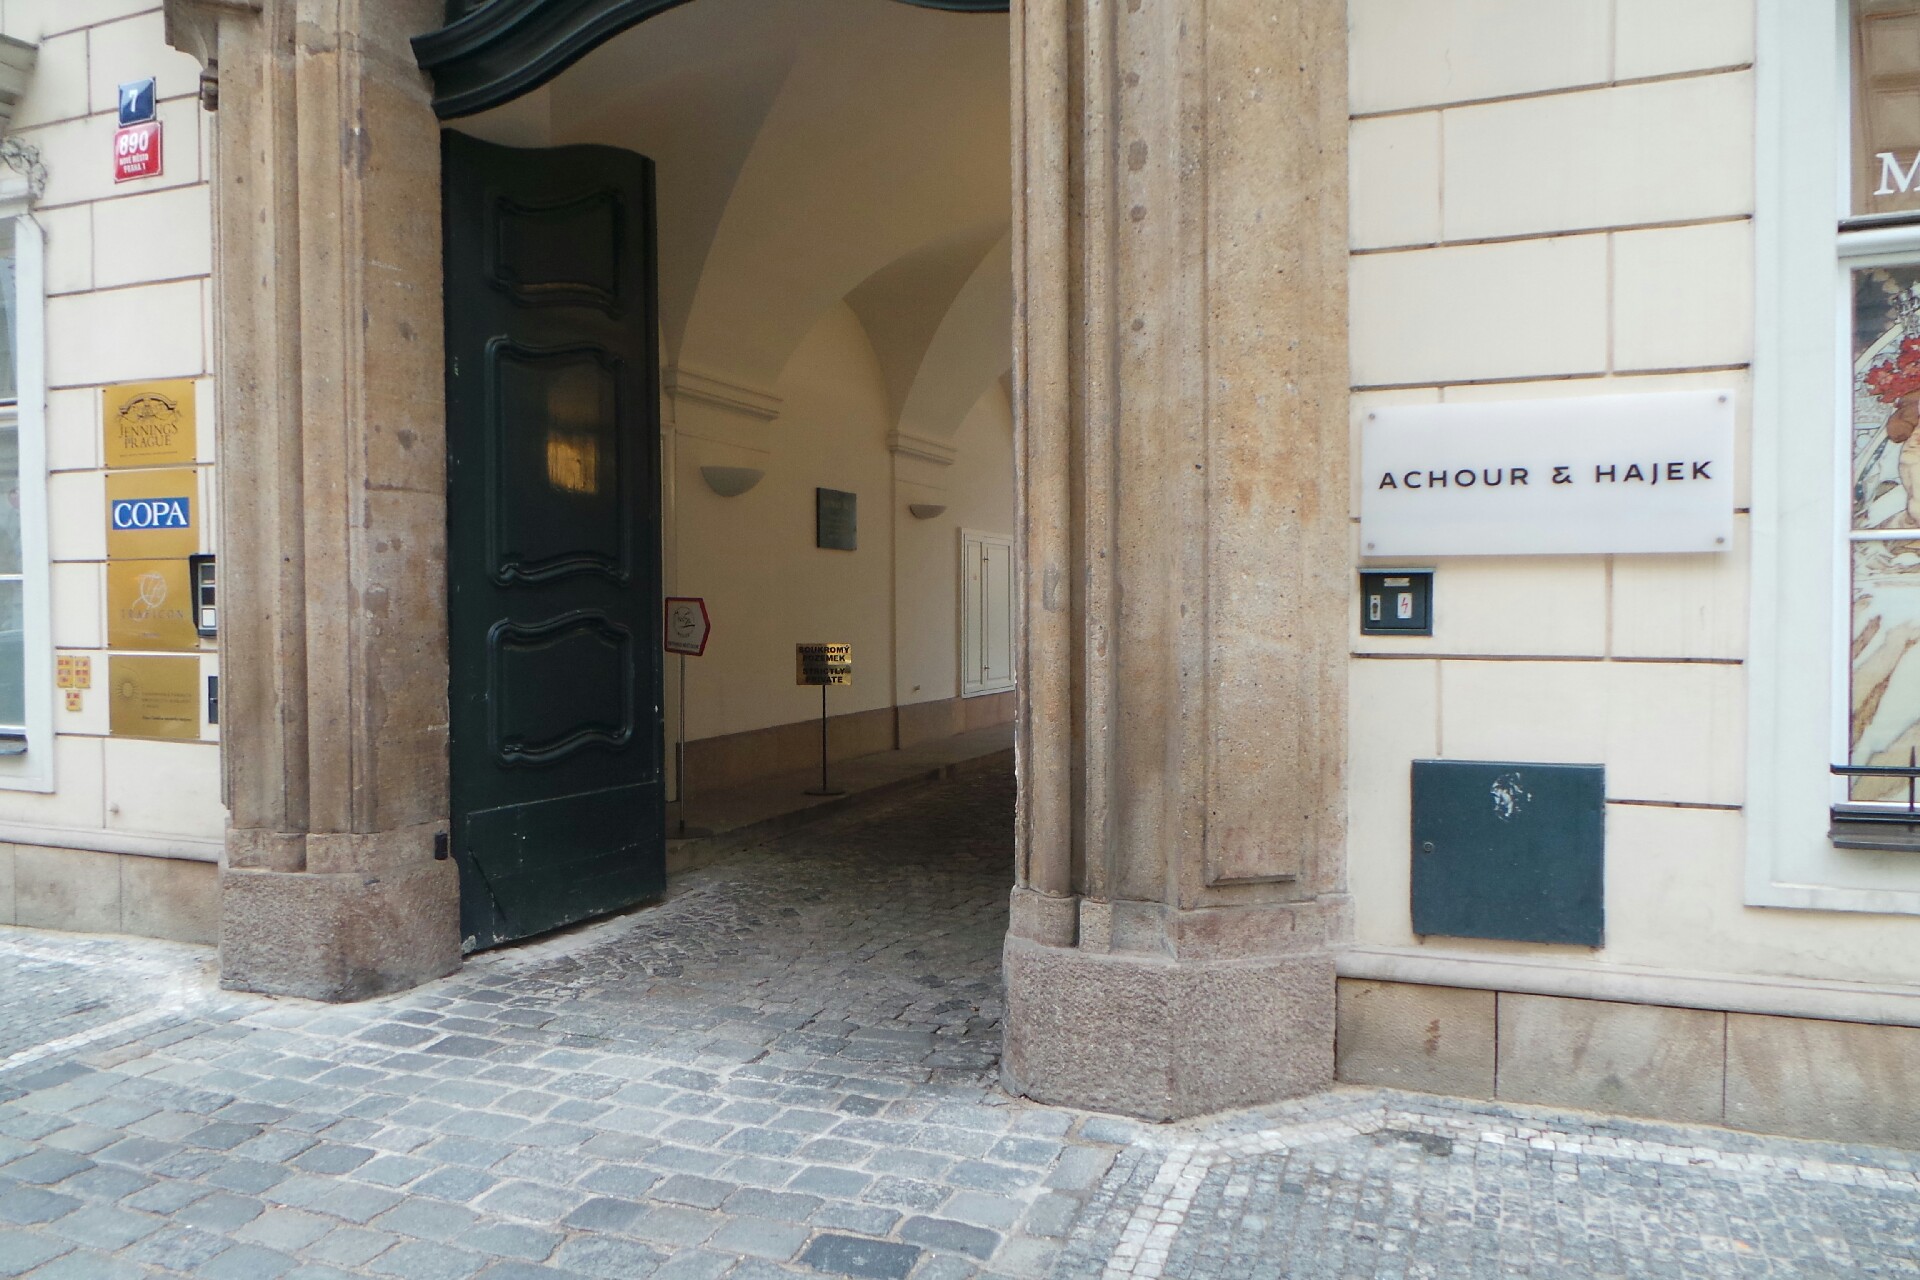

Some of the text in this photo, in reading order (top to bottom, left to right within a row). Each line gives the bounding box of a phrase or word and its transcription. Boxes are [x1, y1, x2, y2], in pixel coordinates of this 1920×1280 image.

[129, 89, 139, 113] 7
[119, 131, 149, 156] 890
[119, 423, 179, 439] JENNINGS
[124, 434, 172, 449] PRAGUE
[1378, 460, 1713, 490] ACHOUR & HAJEK
[114, 501, 188, 528] COPA
[798, 645, 850, 654] SOUKROMÝ
